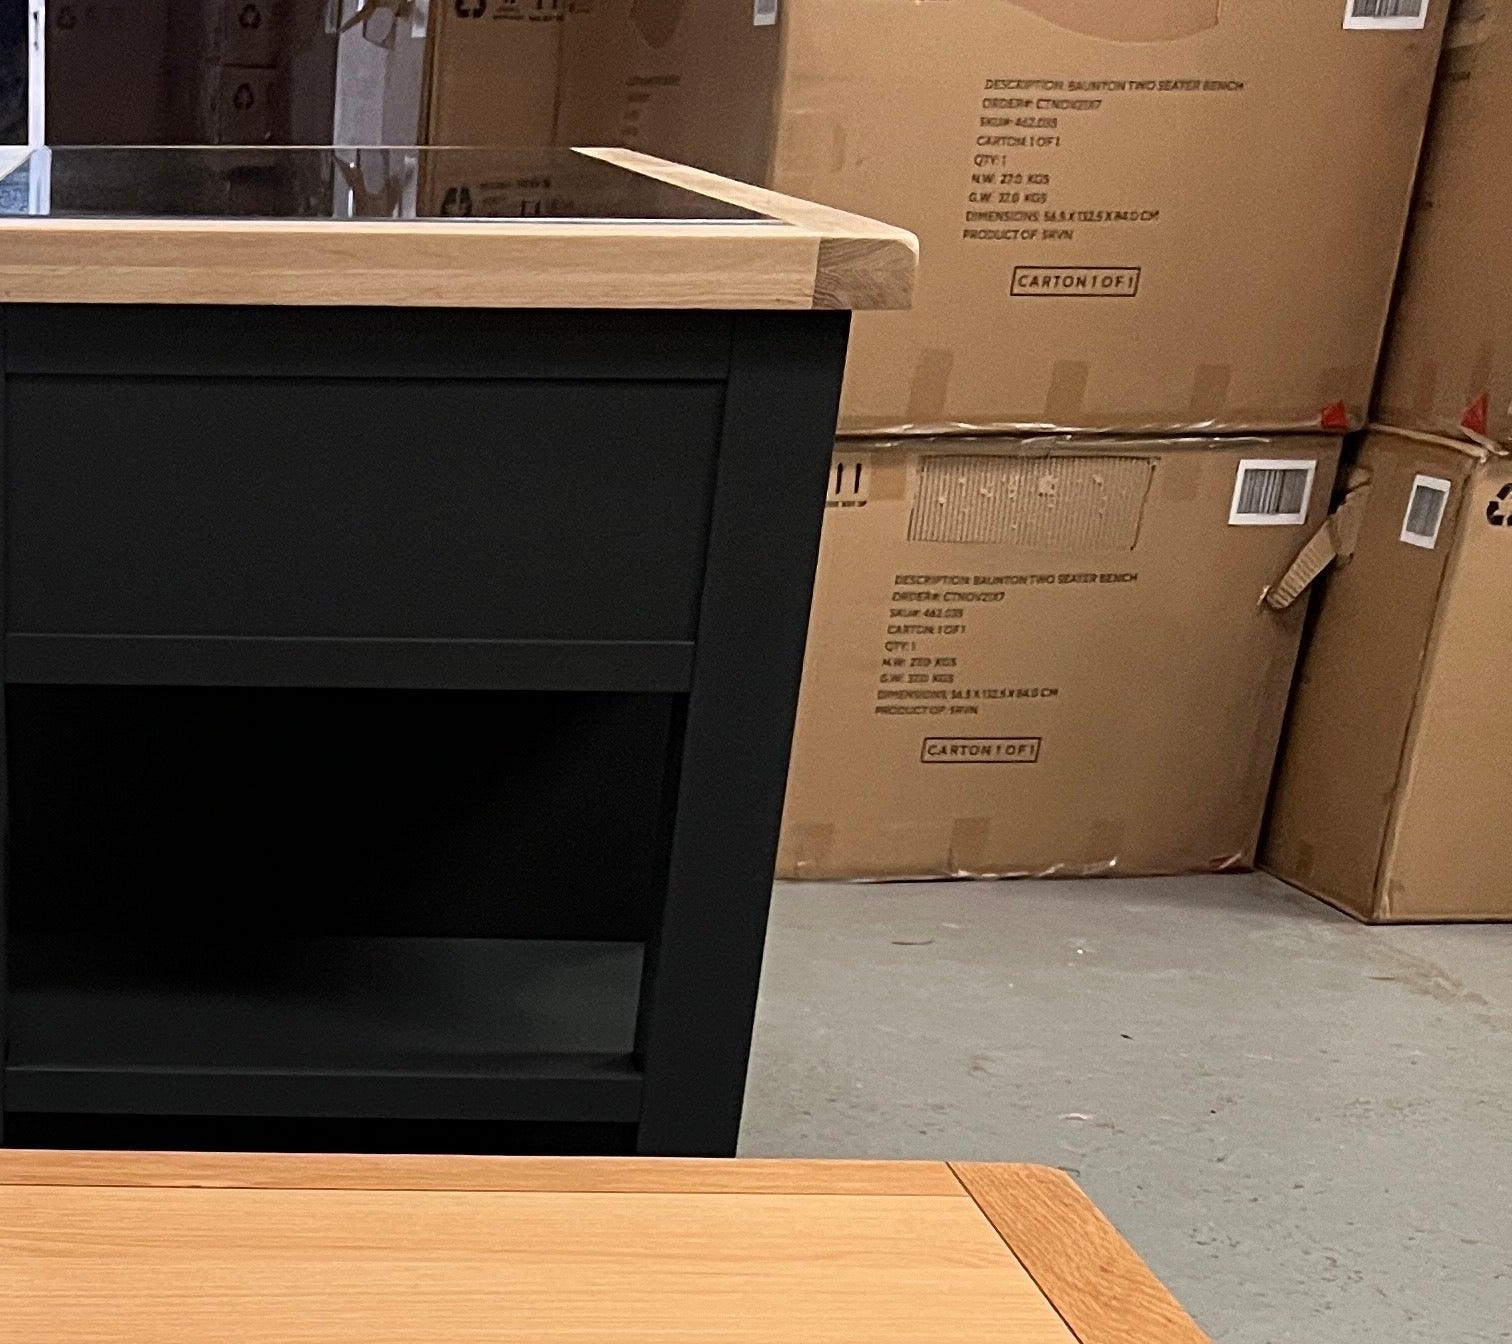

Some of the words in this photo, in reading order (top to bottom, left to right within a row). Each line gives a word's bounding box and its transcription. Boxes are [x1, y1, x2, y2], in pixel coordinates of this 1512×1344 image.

[1129, 80, 1156, 91] TWO
[1157, 80, 1200, 91] SEATER
[1036, 136, 1055, 147] OF
[1027, 174, 1050, 185] KGS
[962, 229, 1019, 241] PRODUCT
[1017, 274, 1087, 289] CARTON
[1101, 274, 1126, 289] OF
[1029, 574, 1055, 585] TWO
[943, 624, 961, 635] OF
[875, 705, 926, 715] PRODUCT
[927, 745, 992, 756] CARTON
[1005, 744, 1026, 756] OF
